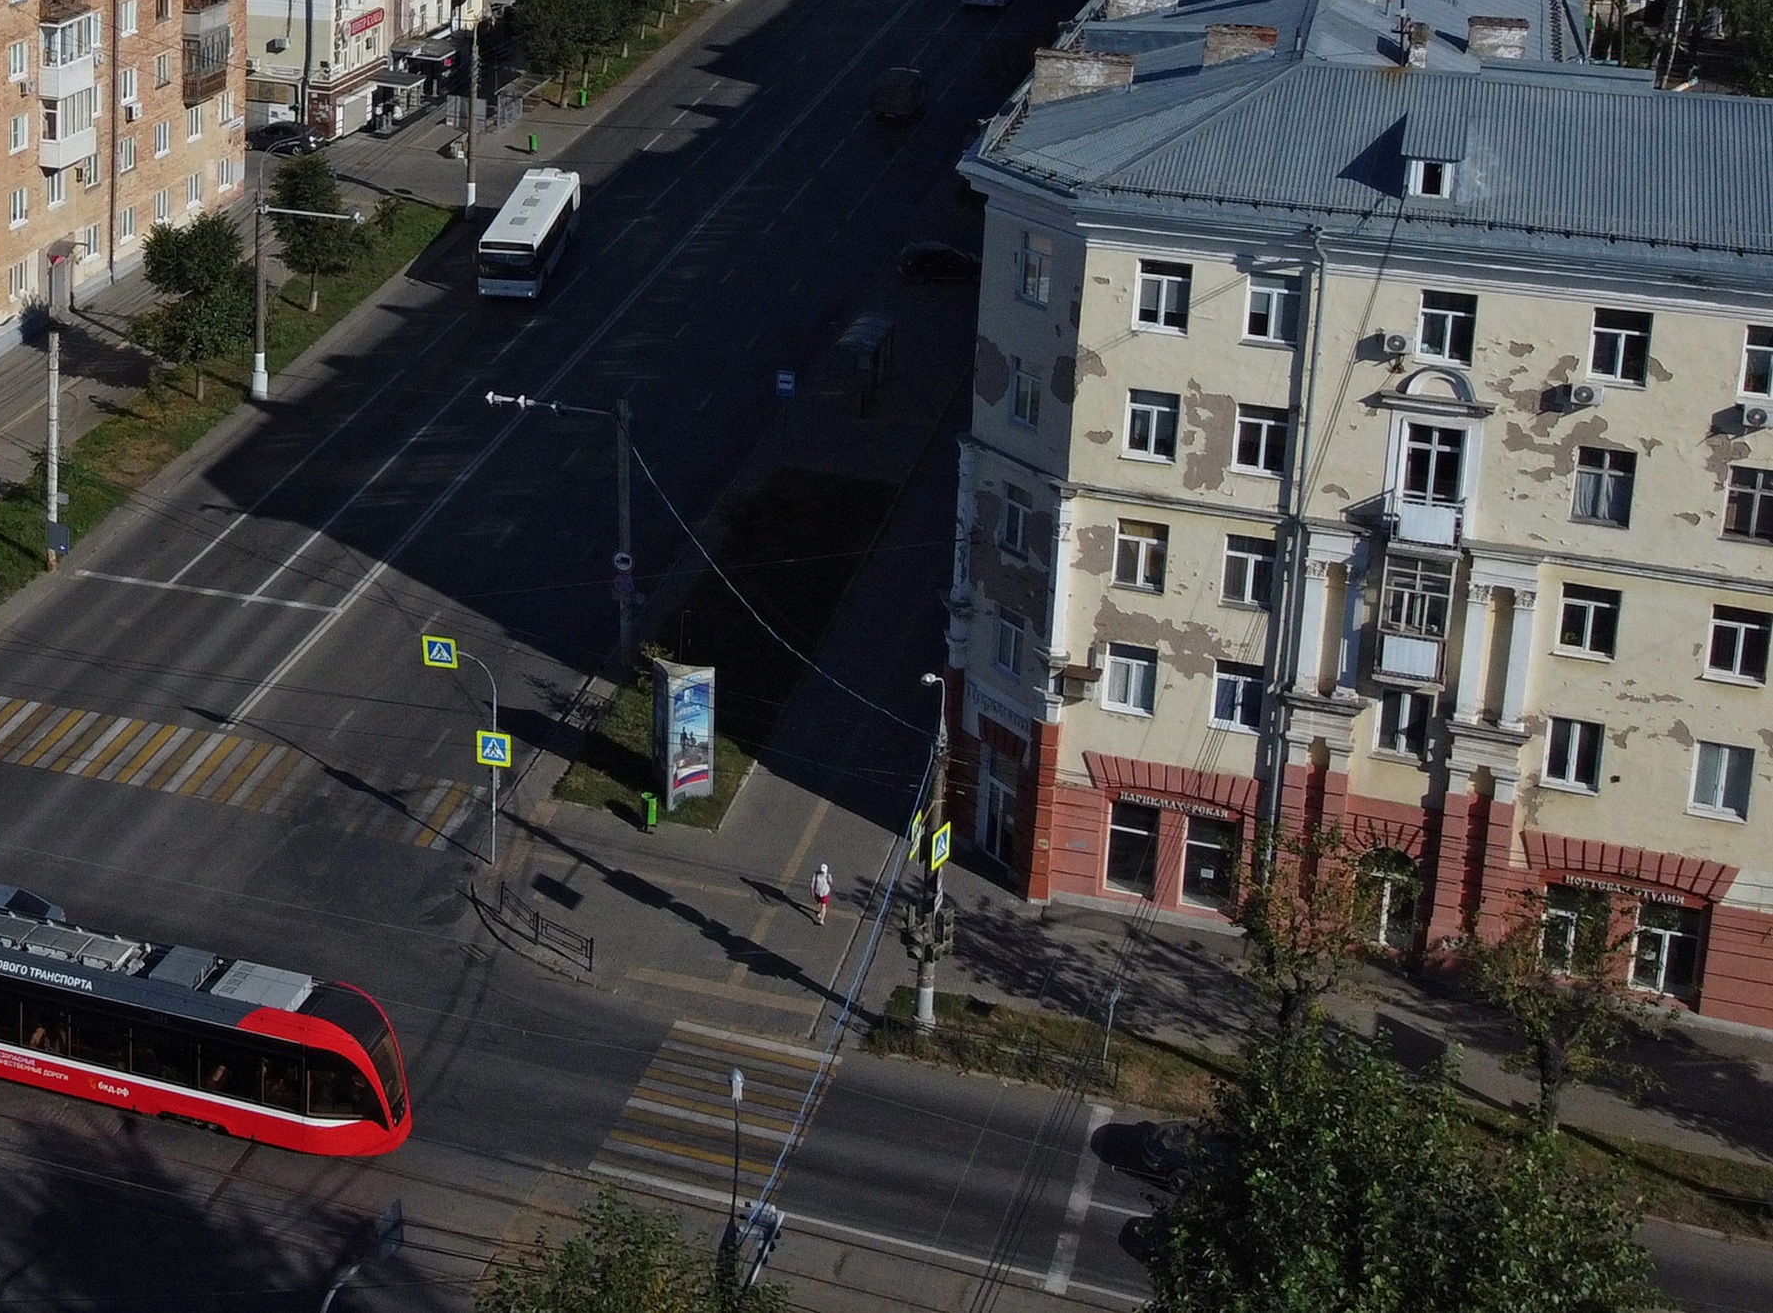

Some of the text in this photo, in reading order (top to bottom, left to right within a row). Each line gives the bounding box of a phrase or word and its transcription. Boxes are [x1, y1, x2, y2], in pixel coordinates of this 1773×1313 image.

[29, 967, 93, 991] ТРАНСПОРТА
[43, 1068, 69, 1081] ДОРОГИ
[98, 1081, 130, 1098] бкд.рф
